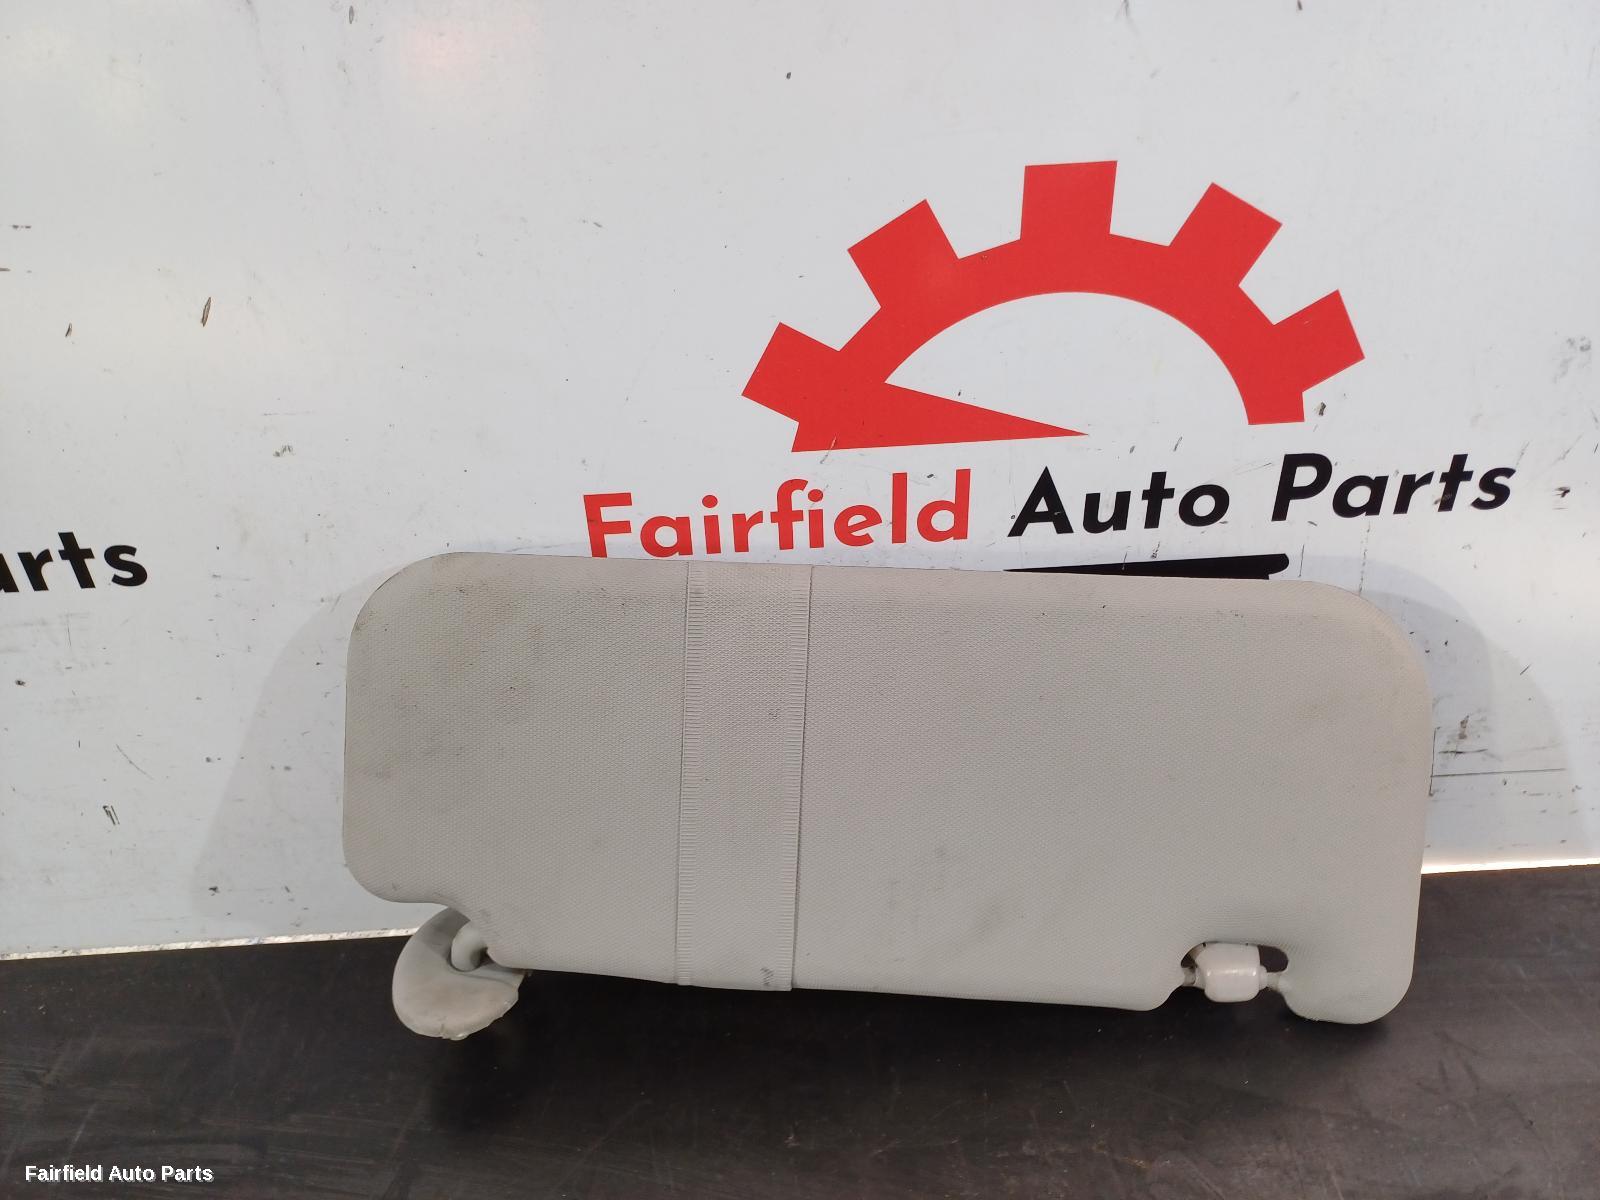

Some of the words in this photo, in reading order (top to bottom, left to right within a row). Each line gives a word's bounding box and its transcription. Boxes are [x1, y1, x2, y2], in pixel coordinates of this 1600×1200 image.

[583, 467, 972, 559] Fairfield
[1008, 465, 1231, 538] Auto
[1271, 452, 1517, 522] Parts
